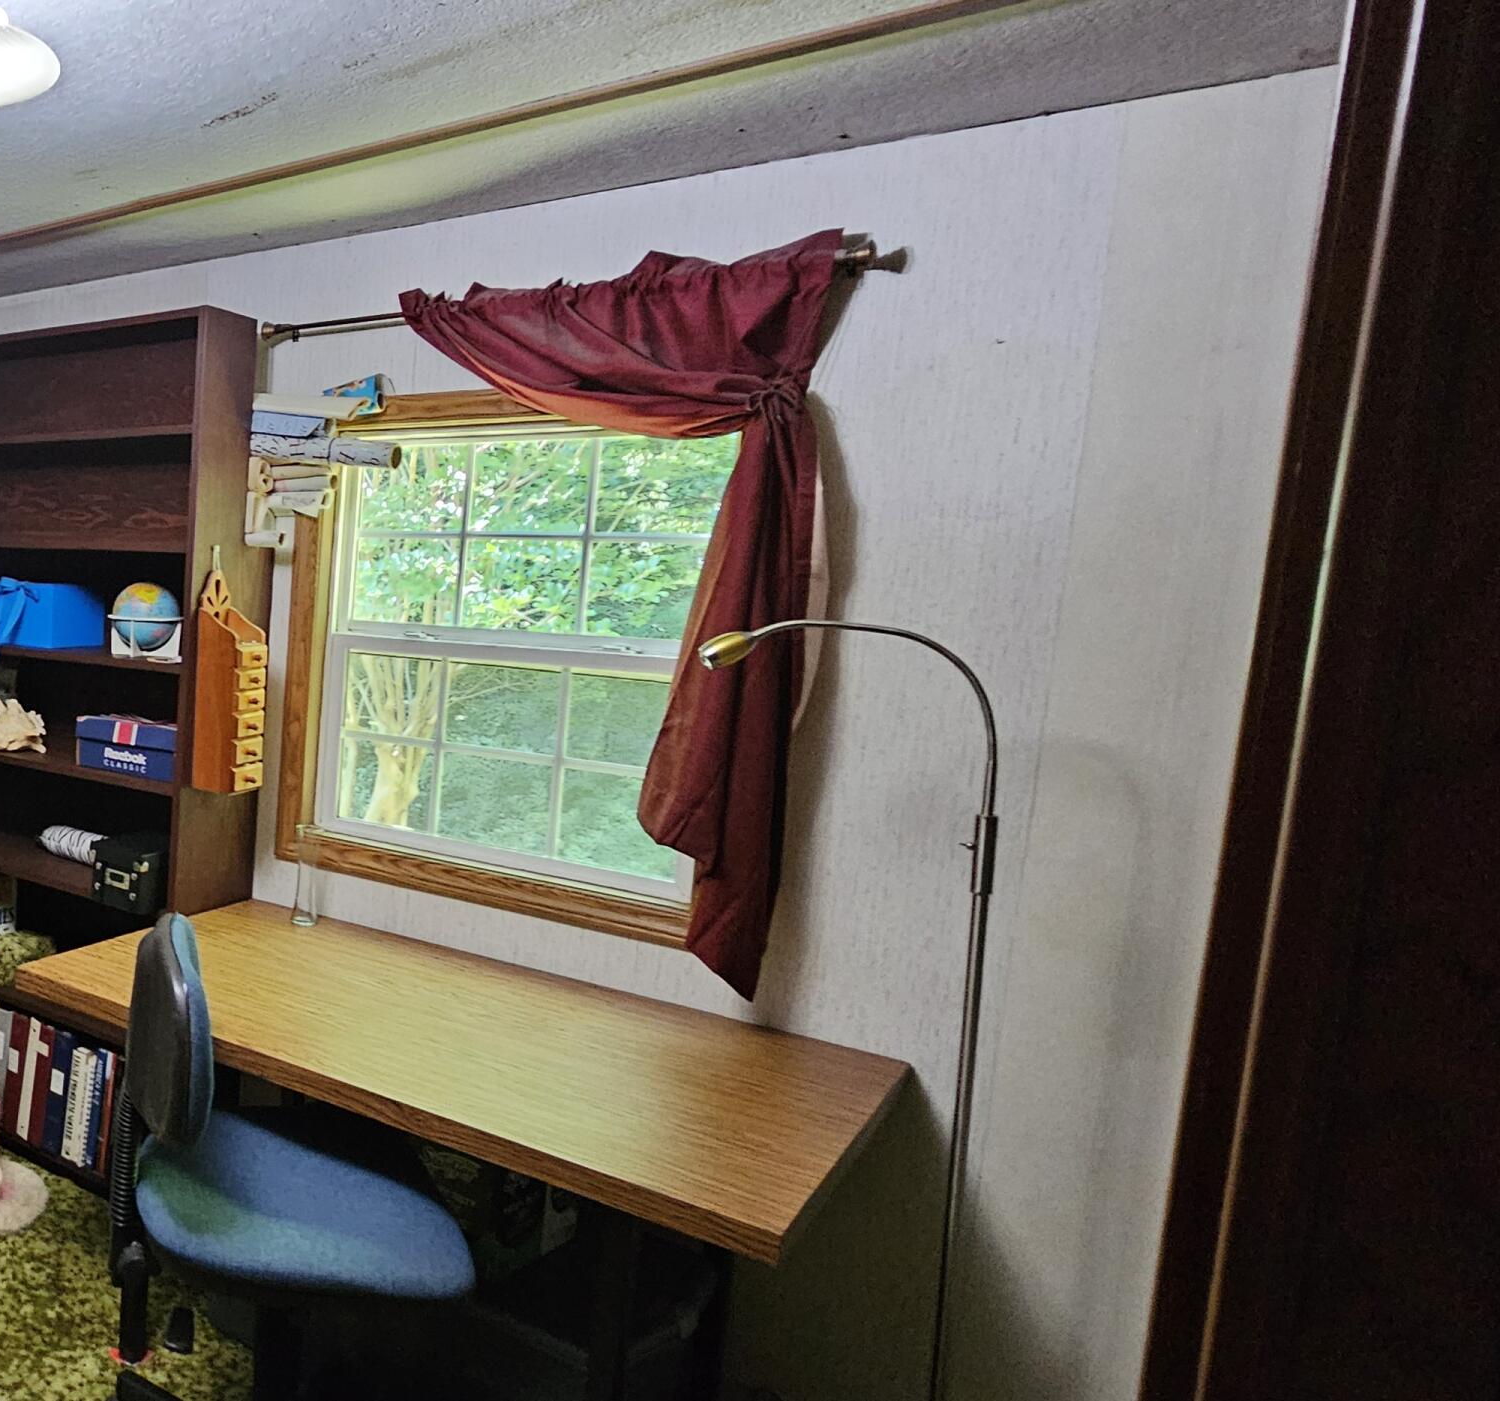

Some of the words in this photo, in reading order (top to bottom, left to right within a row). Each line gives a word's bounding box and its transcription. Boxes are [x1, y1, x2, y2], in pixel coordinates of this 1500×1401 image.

[104, 747, 148, 766] Reebok
[103, 759, 147, 774] CLASSIC
[93, 1059, 105, 1090] AMERICA
